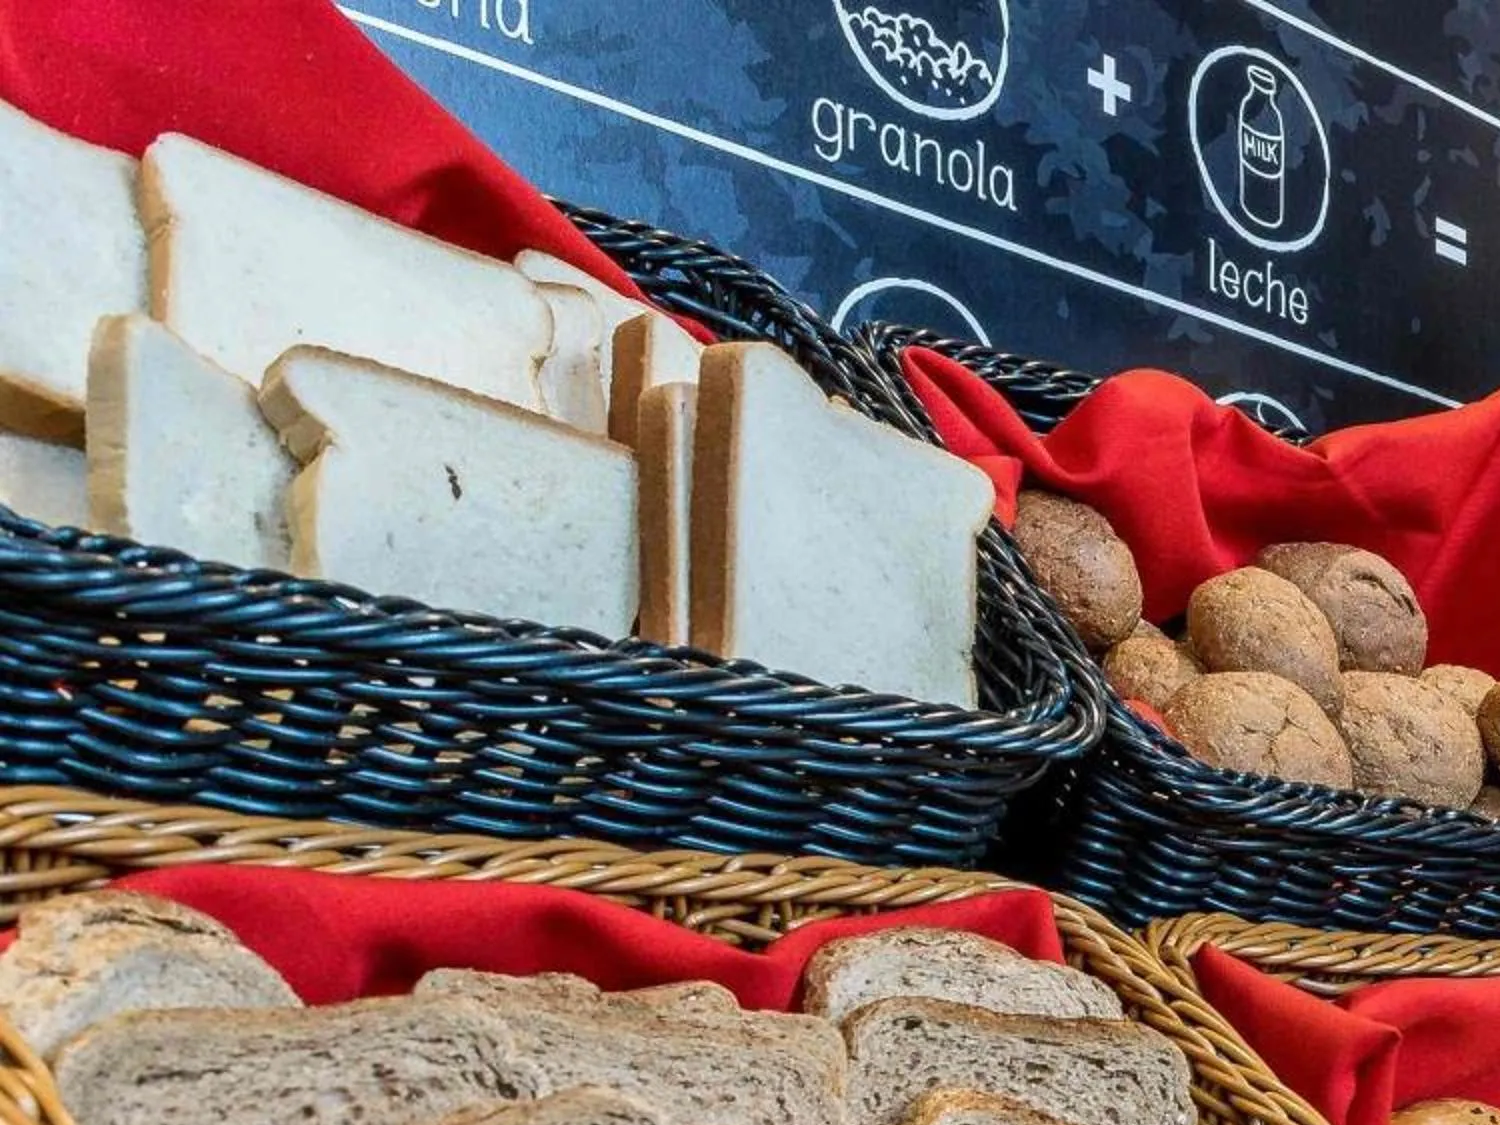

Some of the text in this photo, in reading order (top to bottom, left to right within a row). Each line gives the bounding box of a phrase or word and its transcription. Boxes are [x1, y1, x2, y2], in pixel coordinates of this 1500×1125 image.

[812, 97, 1018, 211] granola
[1243, 132, 1279, 165] MILK
[1208, 237, 1309, 325] leche
